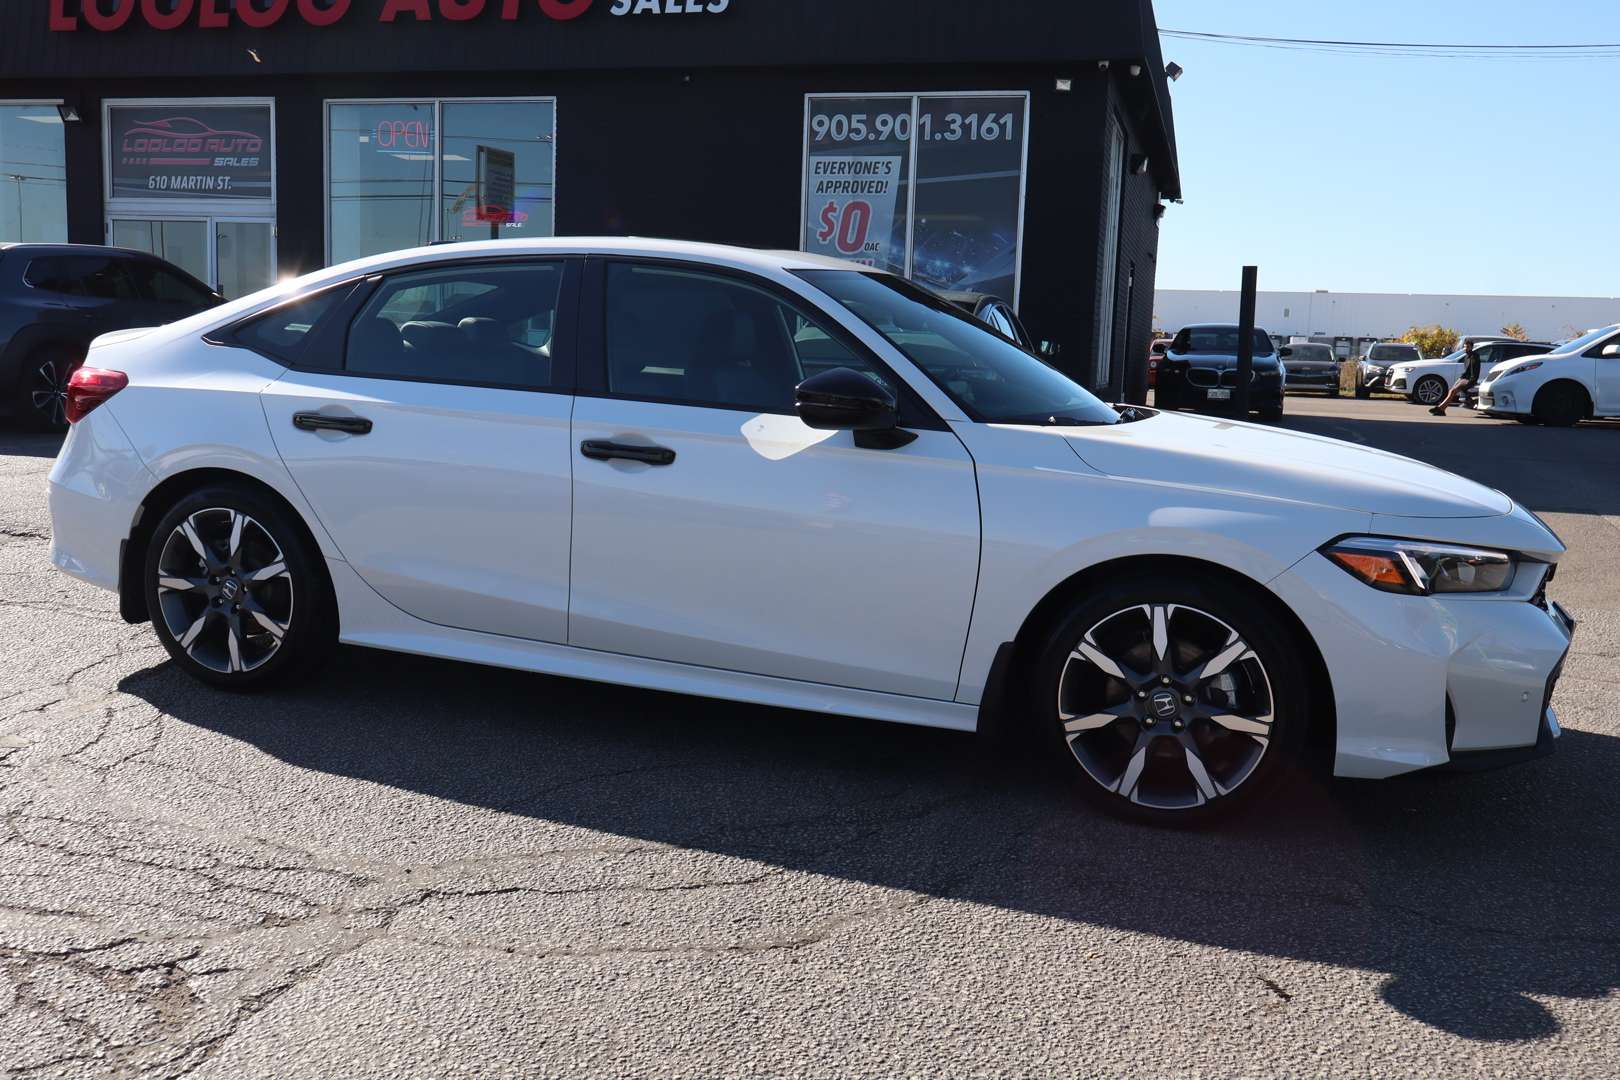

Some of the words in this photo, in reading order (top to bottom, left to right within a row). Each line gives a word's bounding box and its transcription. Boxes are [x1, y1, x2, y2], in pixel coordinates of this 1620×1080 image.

[50, 0, 351, 31] LOOLOO
[377, 120, 429, 148] OPEN
[811, 113, 1013, 142] 905.901.3161
[122, 138, 201, 153] LOOLOO
[204, 138, 264, 153] AUTO
[213, 157, 260, 167] SALES
[814, 160, 893, 176] EVERYONE'S
[148, 175, 168, 190] 610
[170, 175, 215, 190] MARTIN
[216, 175, 233, 190] ST.
[815, 180, 889, 195] APPROVED!
[817, 201, 871, 253] $0
[864, 242, 880, 251] OAC
